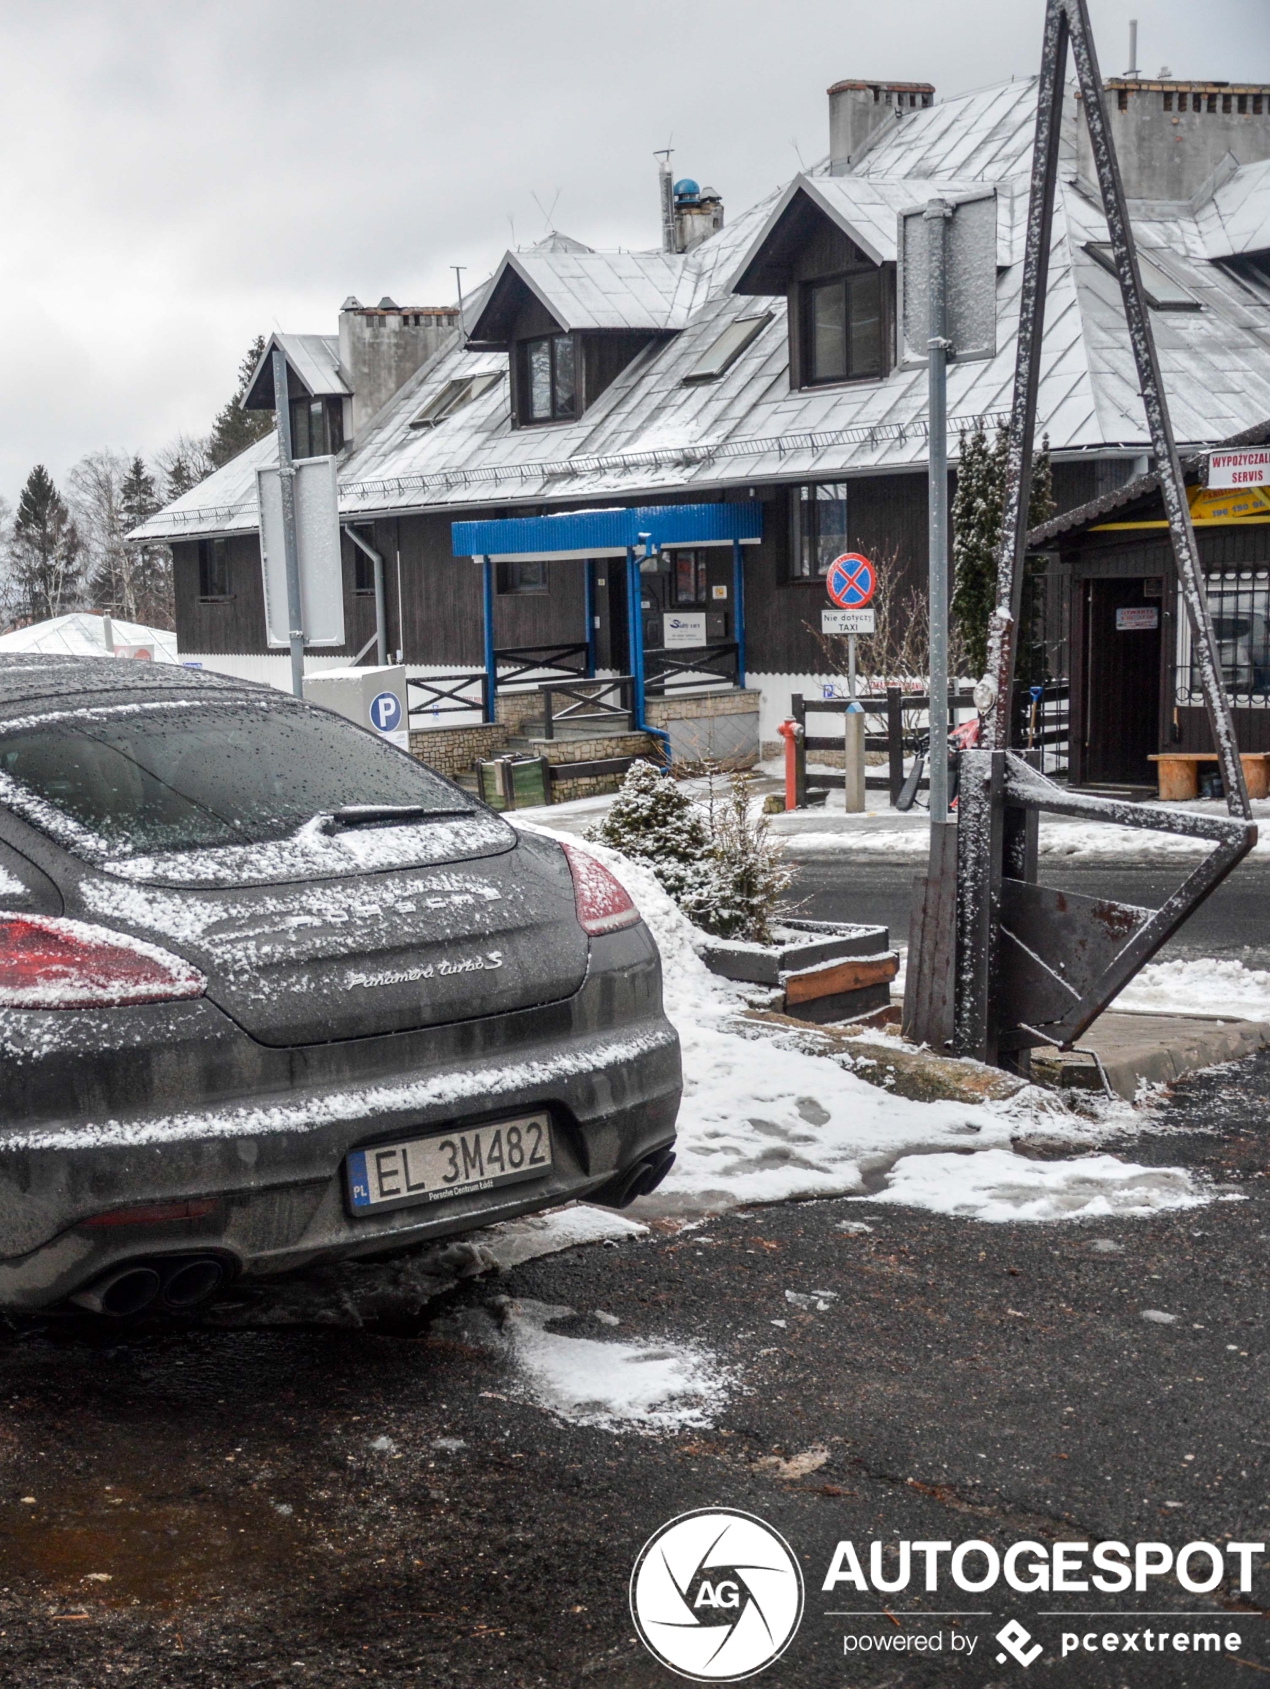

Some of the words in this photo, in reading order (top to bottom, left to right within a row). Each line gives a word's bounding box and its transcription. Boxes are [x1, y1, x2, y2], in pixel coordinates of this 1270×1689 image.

[1232, 470, 1263, 483] SERVIS
[823, 614, 838, 622] Nie
[841, 613, 873, 623] dotyczy
[838, 623, 858, 632] TAXI
[379, 697, 397, 728] P
[347, 965, 435, 991] Panamera
[485, 951, 503, 970] S
[375, 1148, 426, 1198] EL
[438, 1122, 546, 1184] 3M482
[353, 1185, 368, 1199] PL
[428, 1189, 454, 1201] Porsche
[453, 1184, 480, 1196] Centrum
